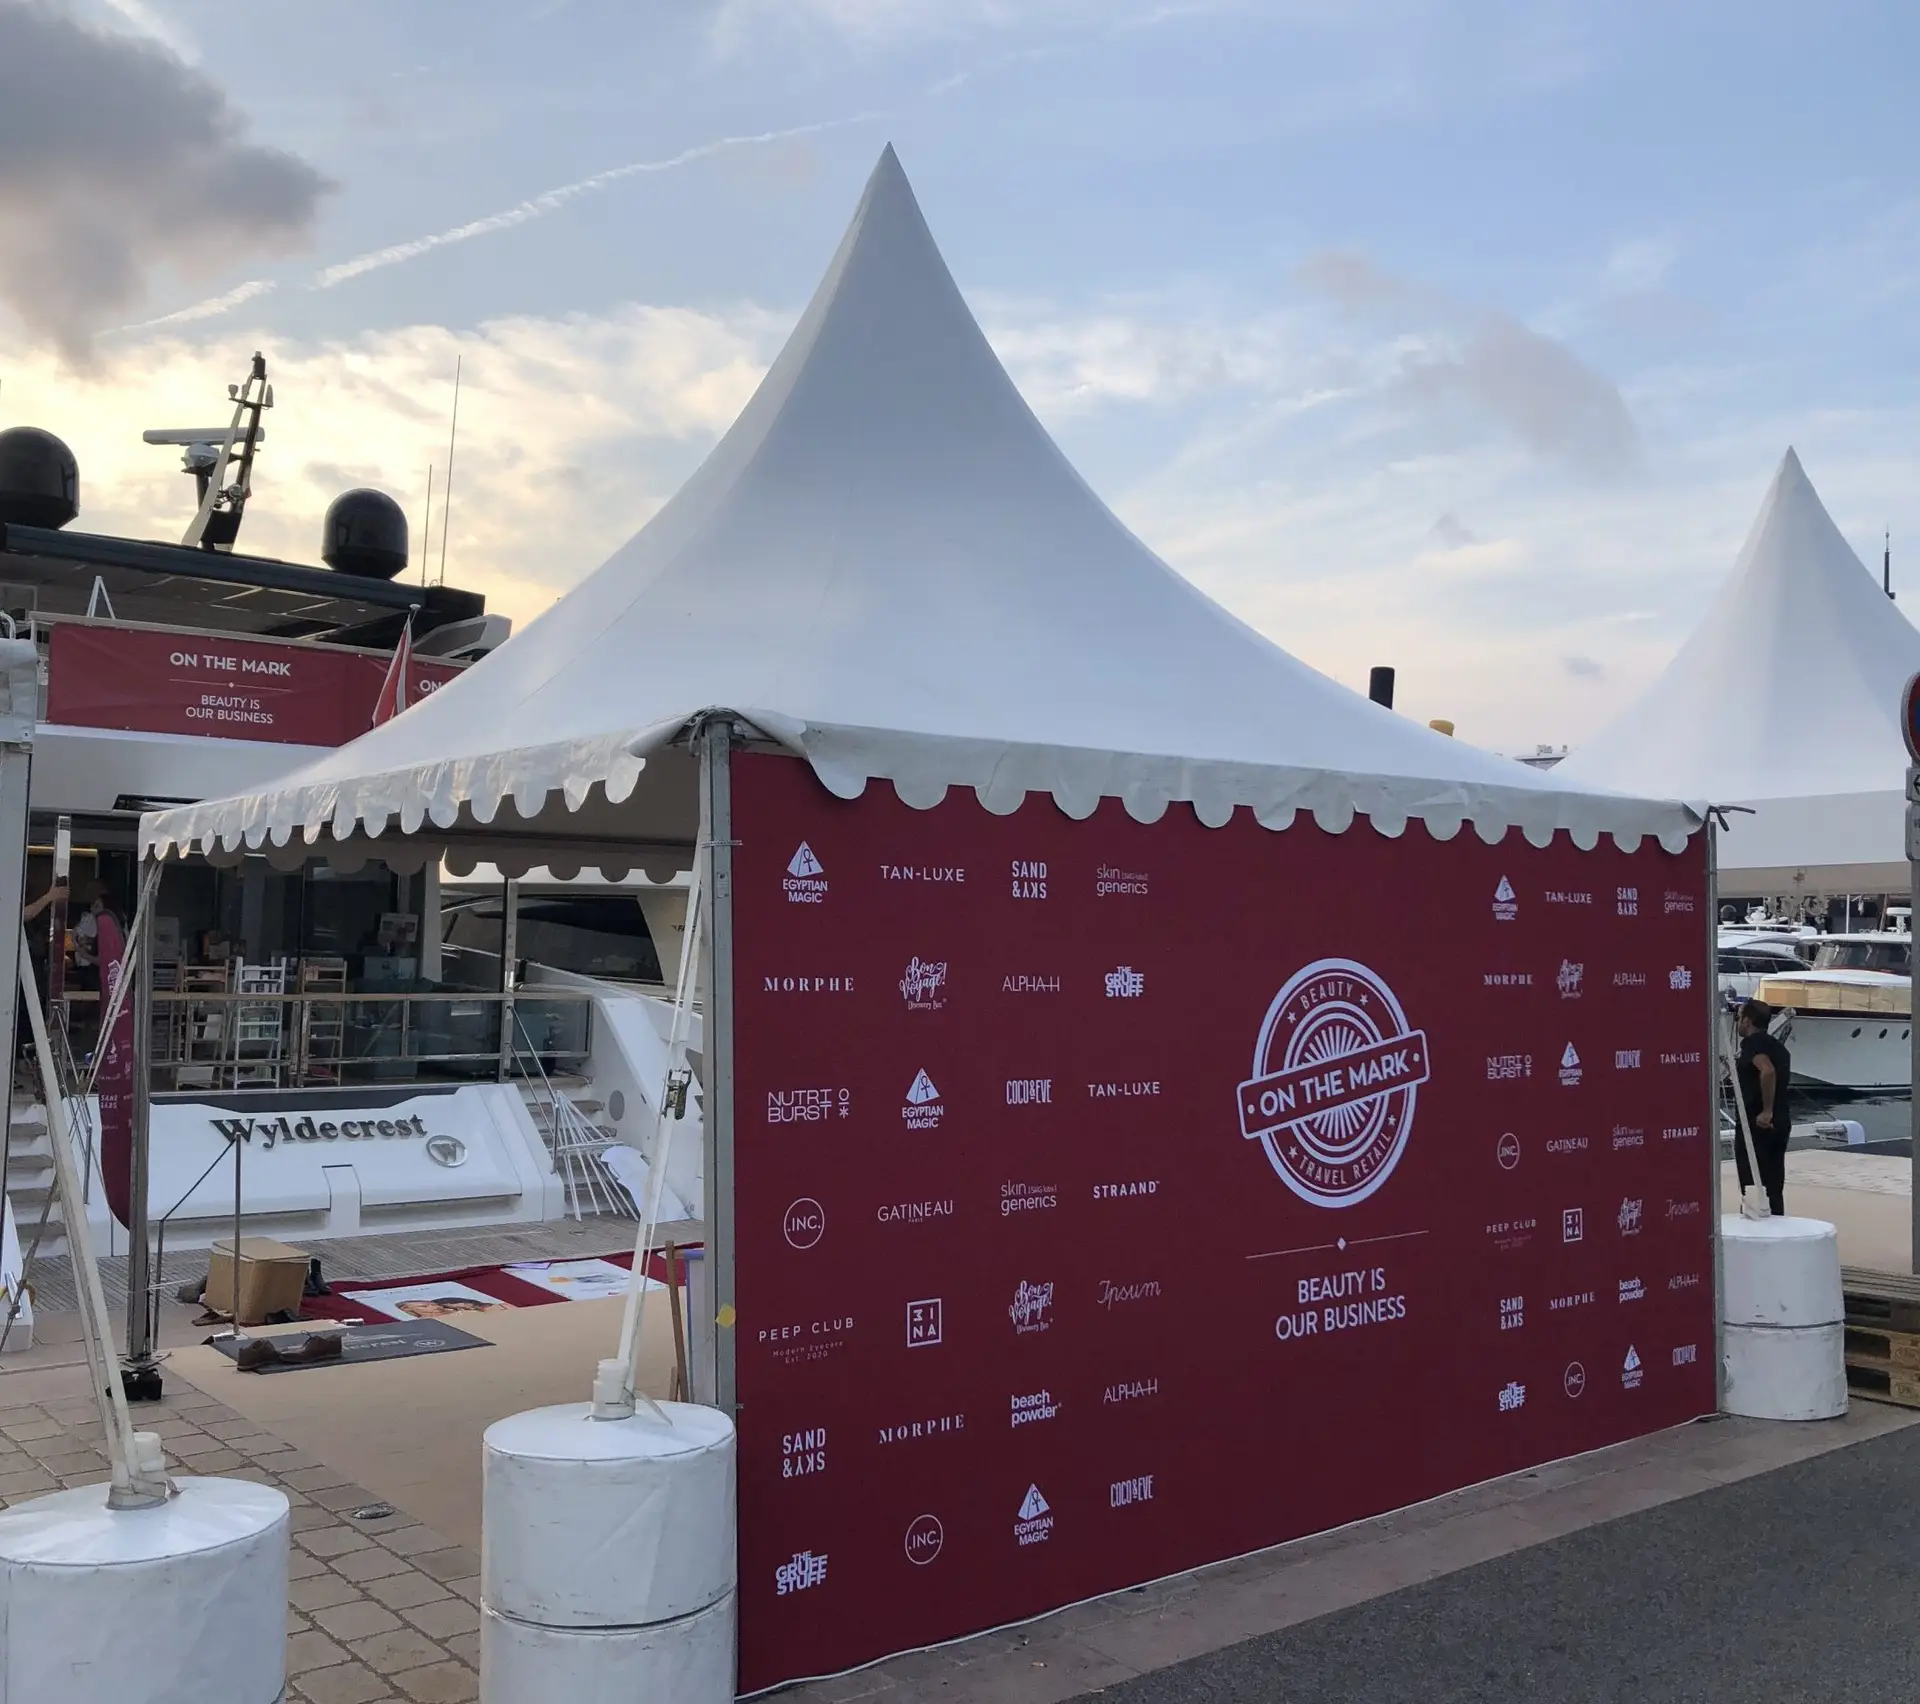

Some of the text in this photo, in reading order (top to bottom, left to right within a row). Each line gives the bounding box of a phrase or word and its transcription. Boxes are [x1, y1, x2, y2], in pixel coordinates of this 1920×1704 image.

[170, 653, 290, 676] ON THE MARK
[202, 695, 260, 710] BEAUTY IS
[186, 707, 273, 724] OUR BUSINESS
[881, 866, 964, 881] TAN-LUXE
[1012, 861, 1046, 878] SAND
[1097, 864, 1120, 879] skin
[783, 879, 827, 892] EGYPTIAN
[1097, 882, 1148, 896] generics
[1617, 887, 1637, 900] SAND
[789, 891, 822, 903] MAGIC
[1546, 892, 1591, 903] TAN-LUXE
[764, 977, 853, 991] MORPHE
[1105, 972, 1144, 988] GRUFF
[1106, 985, 1143, 997] STUFF
[1301, 981, 1353, 1010] BEAUTY
[1660, 1053, 1700, 1063] TAN-LUXE
[1007, 1079, 1051, 1104] COCO&EVE
[1088, 1082, 1160, 1097] TAN-LUXE
[1260, 1050, 1410, 1116] ON THE MARK
[768, 1089, 832, 1106] NUTRI
[768, 1105, 832, 1122] BURST
[902, 1105, 943, 1117] EGYPTIAN
[209, 1114, 428, 1149] Wyldecrest
[907, 1118, 938, 1129] MAGIC
[1547, 1138, 1588, 1152] GATINEAU
[1613, 1135, 1644, 1150] generics
[1298, 1132, 1392, 1186] TRAVEL RETAIL
[1001, 1180, 1026, 1196] skin
[878, 1200, 952, 1222] GATINEAU
[1001, 1196, 1056, 1216] generics
[1487, 1219, 1536, 1233] PEEP CLUB
[1299, 1268, 1385, 1303] BEAUTY IS
[1501, 1296, 1523, 1313] SAND
[1551, 1292, 1594, 1309] MORPHE
[1276, 1296, 1405, 1339] OUR BUSINESS
[759, 1318, 853, 1342] PEEP CLUB
[1011, 1389, 1050, 1410] beach
[1499, 1396, 1525, 1411] STUFF
[1011, 1404, 1057, 1428] powder
[880, 1415, 963, 1443] MORPHE
[783, 1428, 825, 1454] SAND
[1014, 1516, 1054, 1536] EGYPTIAN
[1019, 1531, 1049, 1546] MAGIC
[792, 1550, 811, 1562] THE
[776, 1554, 828, 1581] GRUFF
[777, 1568, 826, 1595] STUFF
